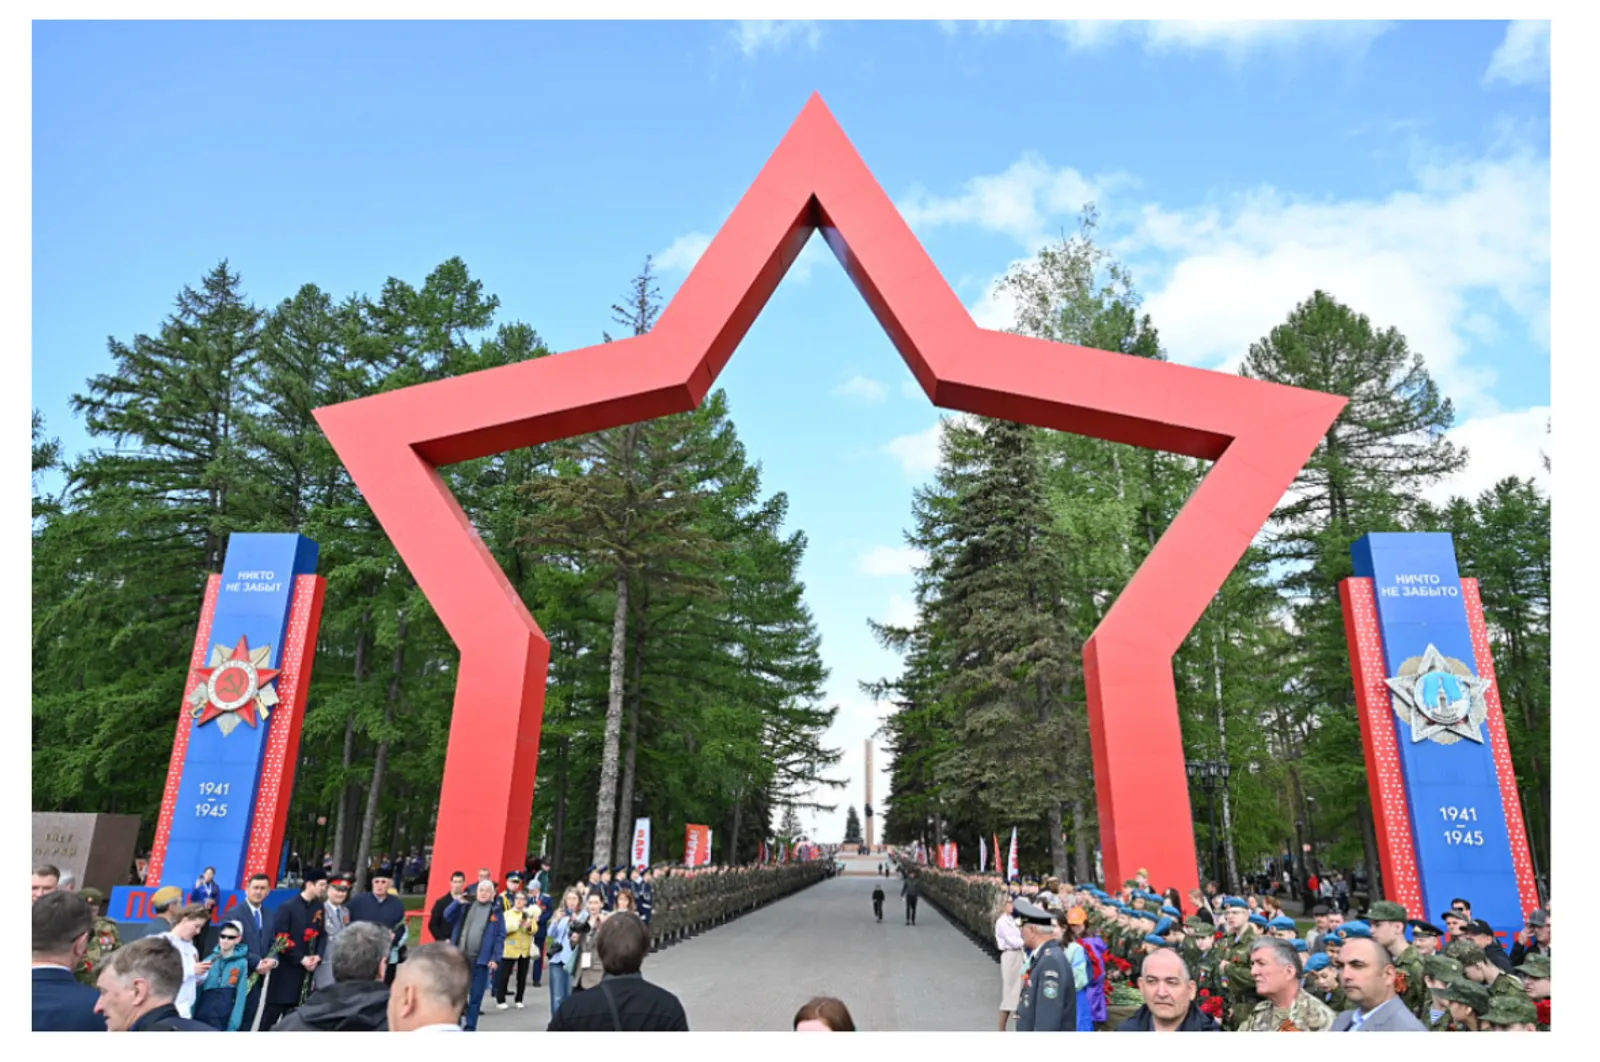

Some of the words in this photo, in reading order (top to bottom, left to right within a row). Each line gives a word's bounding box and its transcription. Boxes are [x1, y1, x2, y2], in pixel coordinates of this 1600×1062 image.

[237, 571, 275, 581] НИКТО
[1395, 574, 1440, 585] НИЧТО
[225, 582, 241, 593] НЕ
[243, 582, 282, 593] ЗАБЫТ
[1382, 586, 1401, 597] НЕ
[1402, 586, 1458, 597] ЗАБЫТО
[199, 782, 230, 796] 1941
[195, 803, 229, 817] 1945
[1440, 806, 1477, 821] 1941
[1444, 830, 1484, 846] 1945
